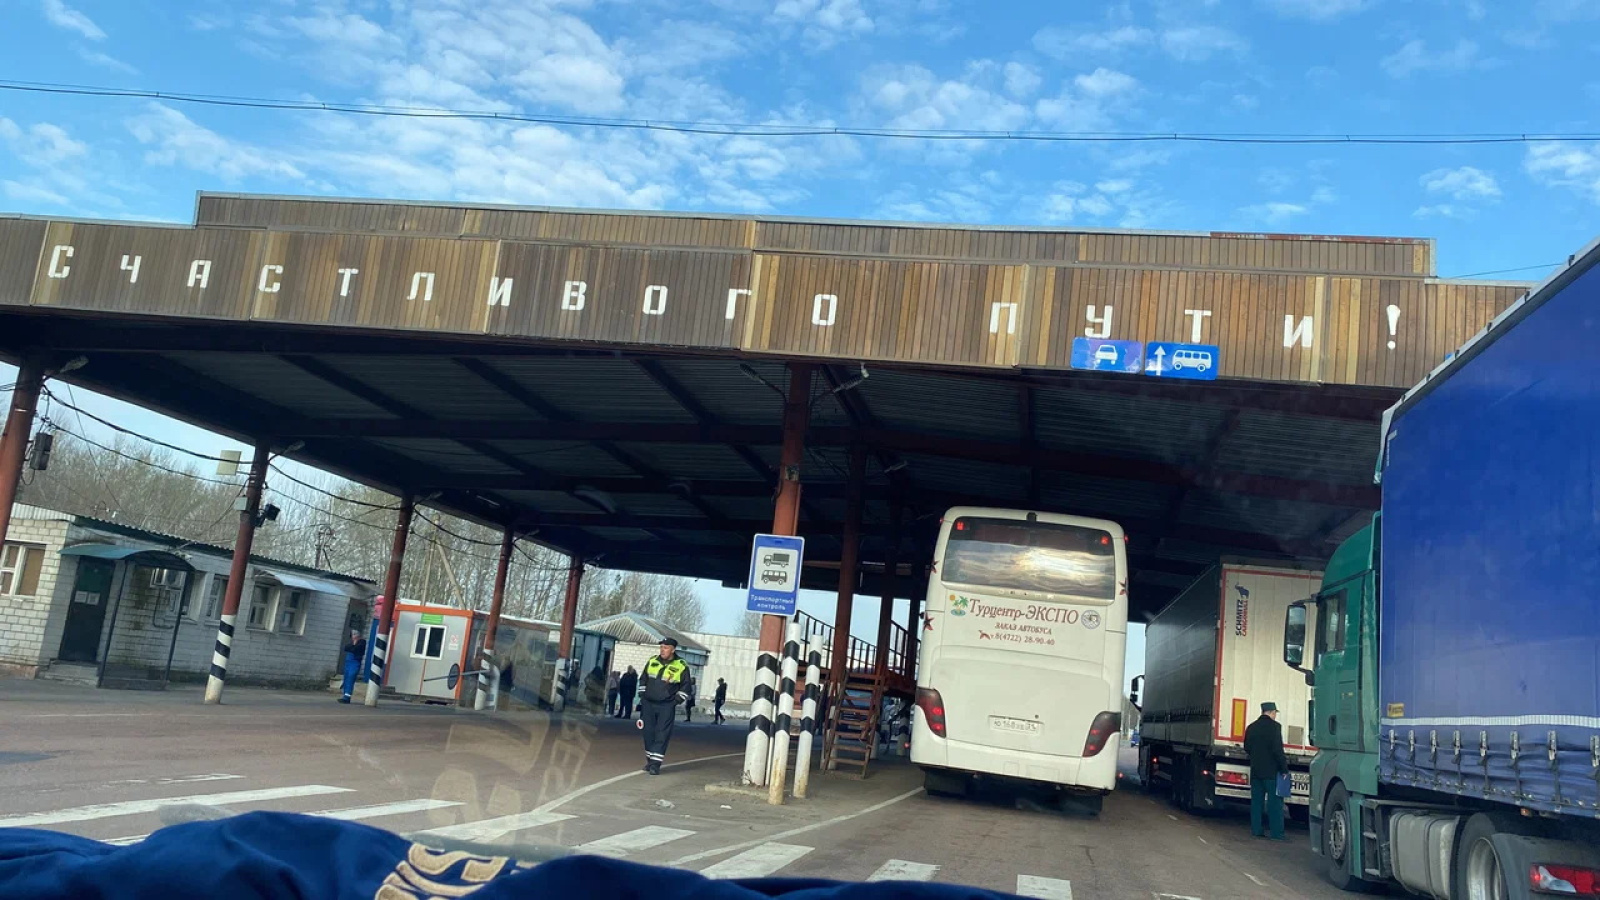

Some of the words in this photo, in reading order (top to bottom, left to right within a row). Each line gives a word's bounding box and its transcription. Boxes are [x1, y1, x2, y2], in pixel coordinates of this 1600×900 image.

[48, 243, 838, 327] СЧАСТЛИВОГО
[990, 301, 1401, 351] ПУТИ!
[750, 594, 794, 604] Транспортный
[969, 598, 1079, 624] Турцентр-ЭКСПО
[995, 621, 1018, 631] ЗАКАЗ
[1018, 625, 1052, 635] АВТОБУСА
